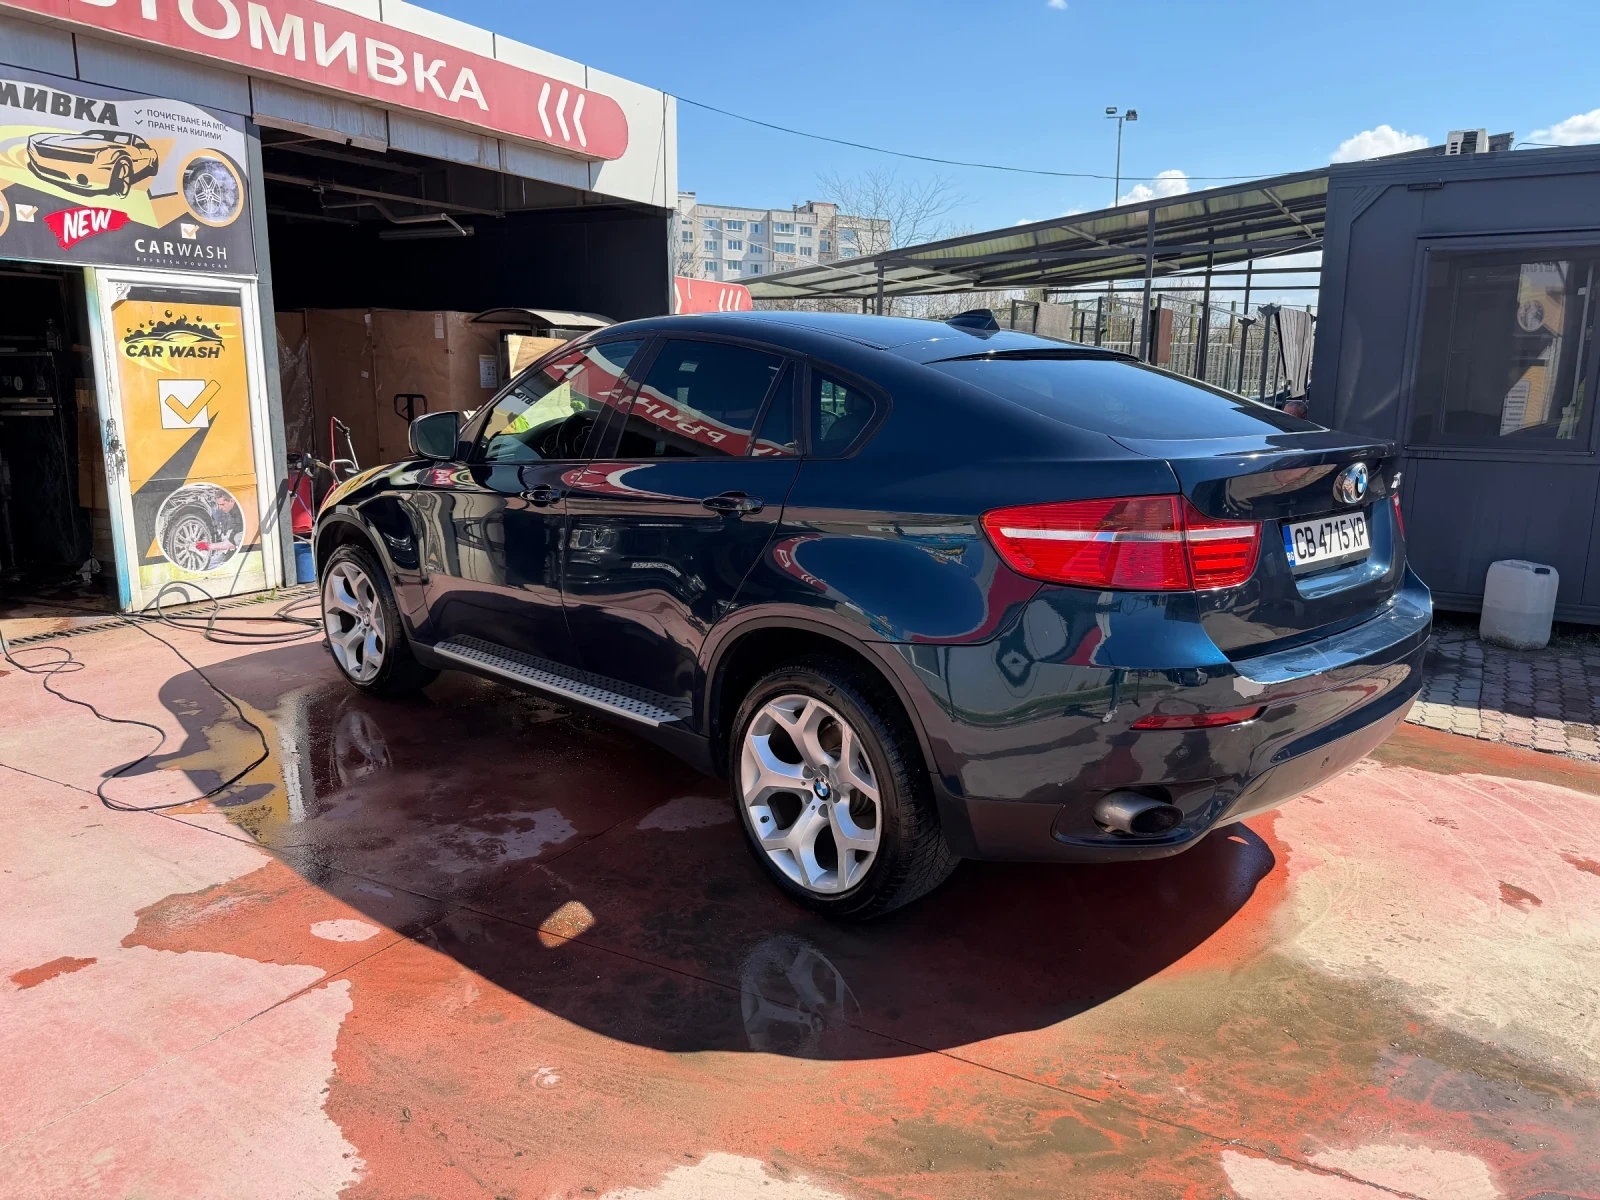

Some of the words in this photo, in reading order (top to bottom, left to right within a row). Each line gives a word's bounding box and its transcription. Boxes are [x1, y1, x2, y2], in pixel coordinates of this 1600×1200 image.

[80, 0, 489, 112] ОМИВКА
[146, 109, 200, 126] ПОЧИСТВАНЕ
[201, 118, 212, 128] НА
[212, 121, 229, 132] МПС
[147, 120, 175, 132] ПРАНЕ
[177, 125, 189, 135] НА
[189, 128, 222, 141] КИЛИМИ
[63, 209, 112, 243] NEW
[125, 344, 164, 357] CAR
[168, 345, 221, 359] WASH
[1294, 526, 1316, 559] CB
[1319, 520, 1349, 554] 4715
[1350, 516, 1365, 548] XP
